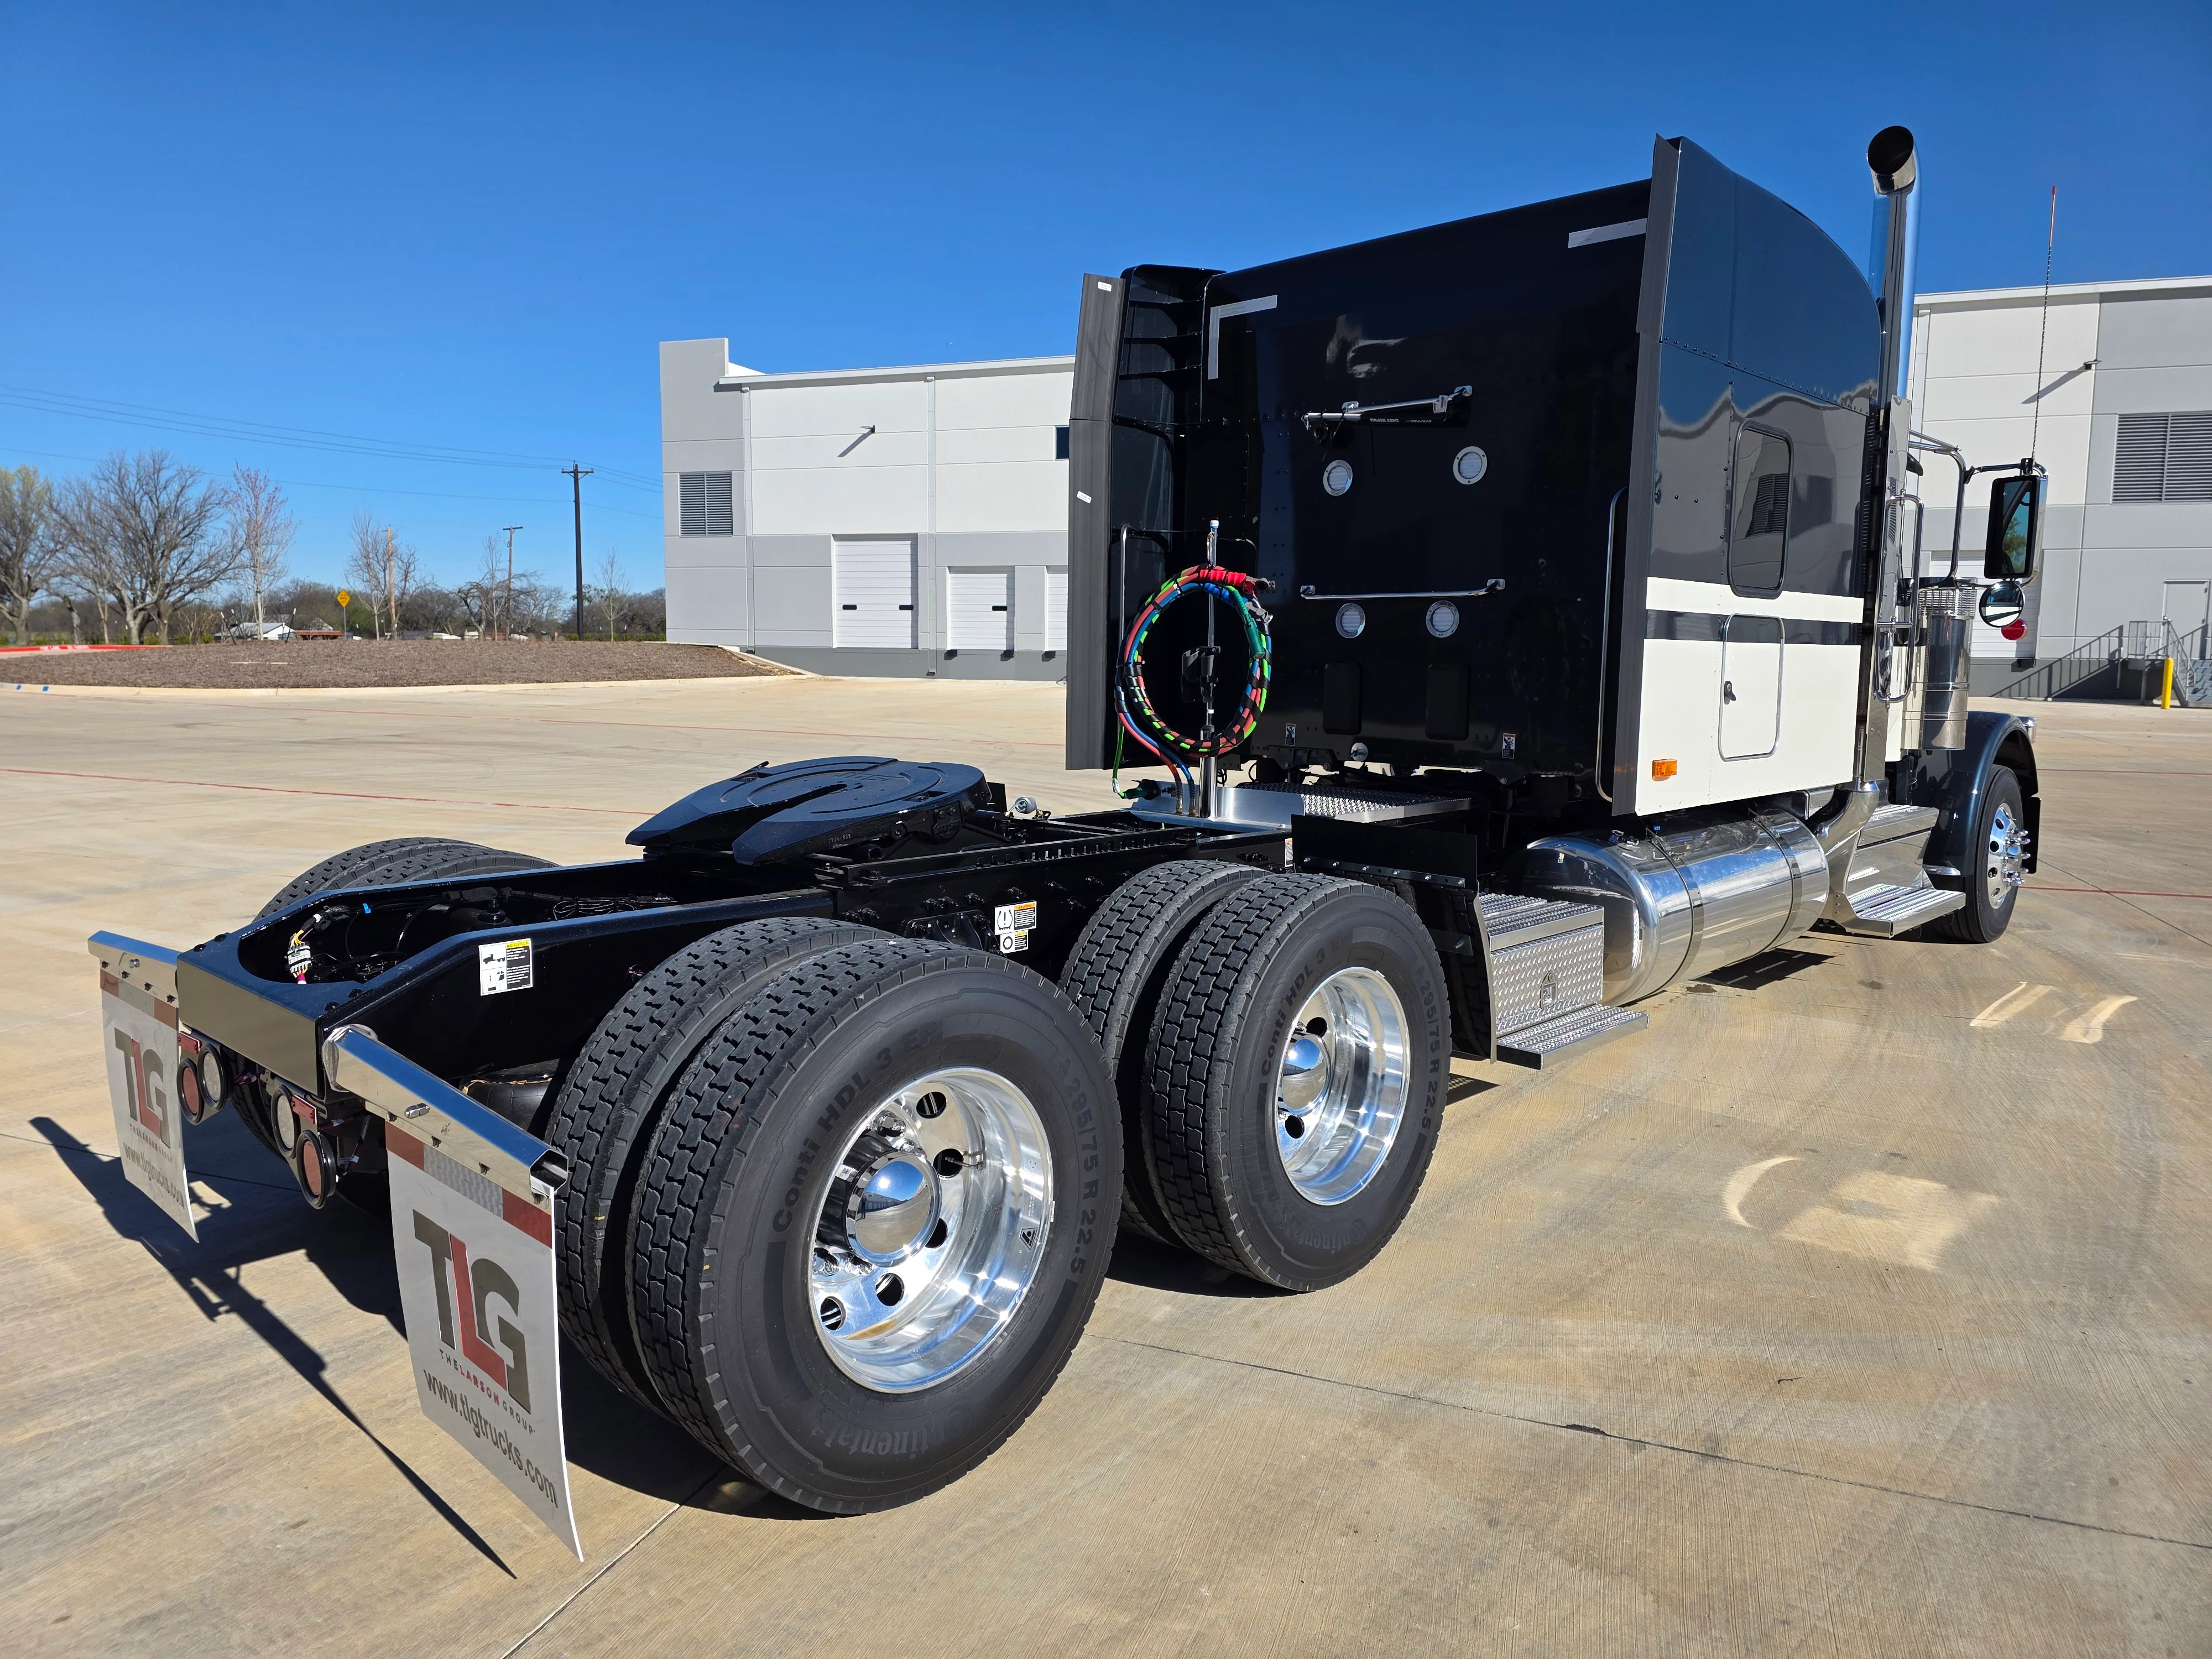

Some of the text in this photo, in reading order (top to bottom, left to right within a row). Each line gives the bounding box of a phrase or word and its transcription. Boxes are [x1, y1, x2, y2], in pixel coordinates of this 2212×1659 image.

[1261, 1009, 1287, 1076] Conti
[1285, 964, 1313, 1007] HDL
[1317, 947, 1326, 964] 3
[1419, 979, 1440, 1130] 295/75 R 22.5
[114, 1027, 171, 1150] TLG
[772, 1138, 821, 1233] Conti
[818, 1072, 872, 1133] HDL
[876, 1047, 893, 1071] 3
[1065, 1077, 1099, 1275] 295/75 R 22.5
[412, 1208, 531, 1415] TLG
[423, 1369, 558, 1508] www.tlgtrucks.com
[502, 1400, 534, 1434] GROUP
